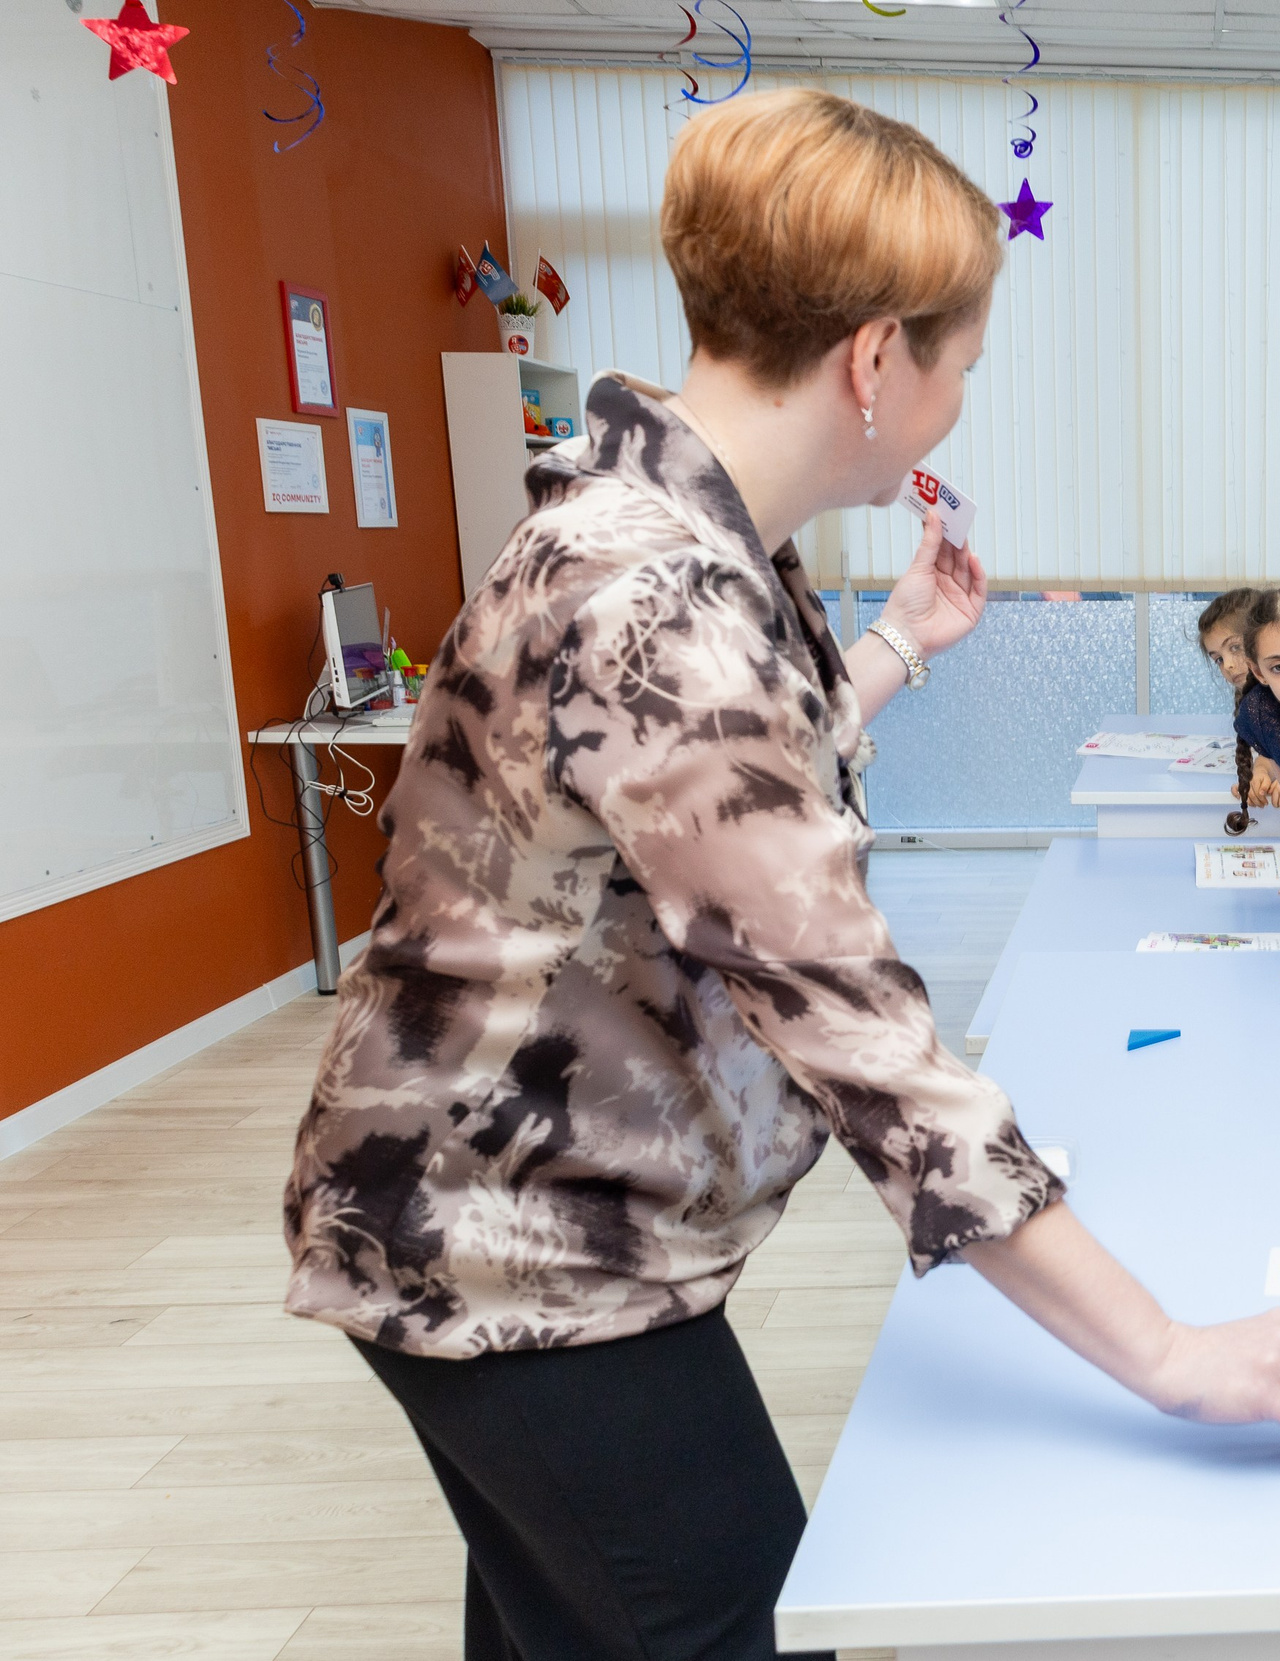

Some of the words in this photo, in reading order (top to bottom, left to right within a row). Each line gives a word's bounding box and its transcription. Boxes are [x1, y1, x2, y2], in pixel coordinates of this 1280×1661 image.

[272, 493, 282, 504] IQ
[281, 493, 322, 503] COMMUNITY
[939, 485, 960, 511] 007
